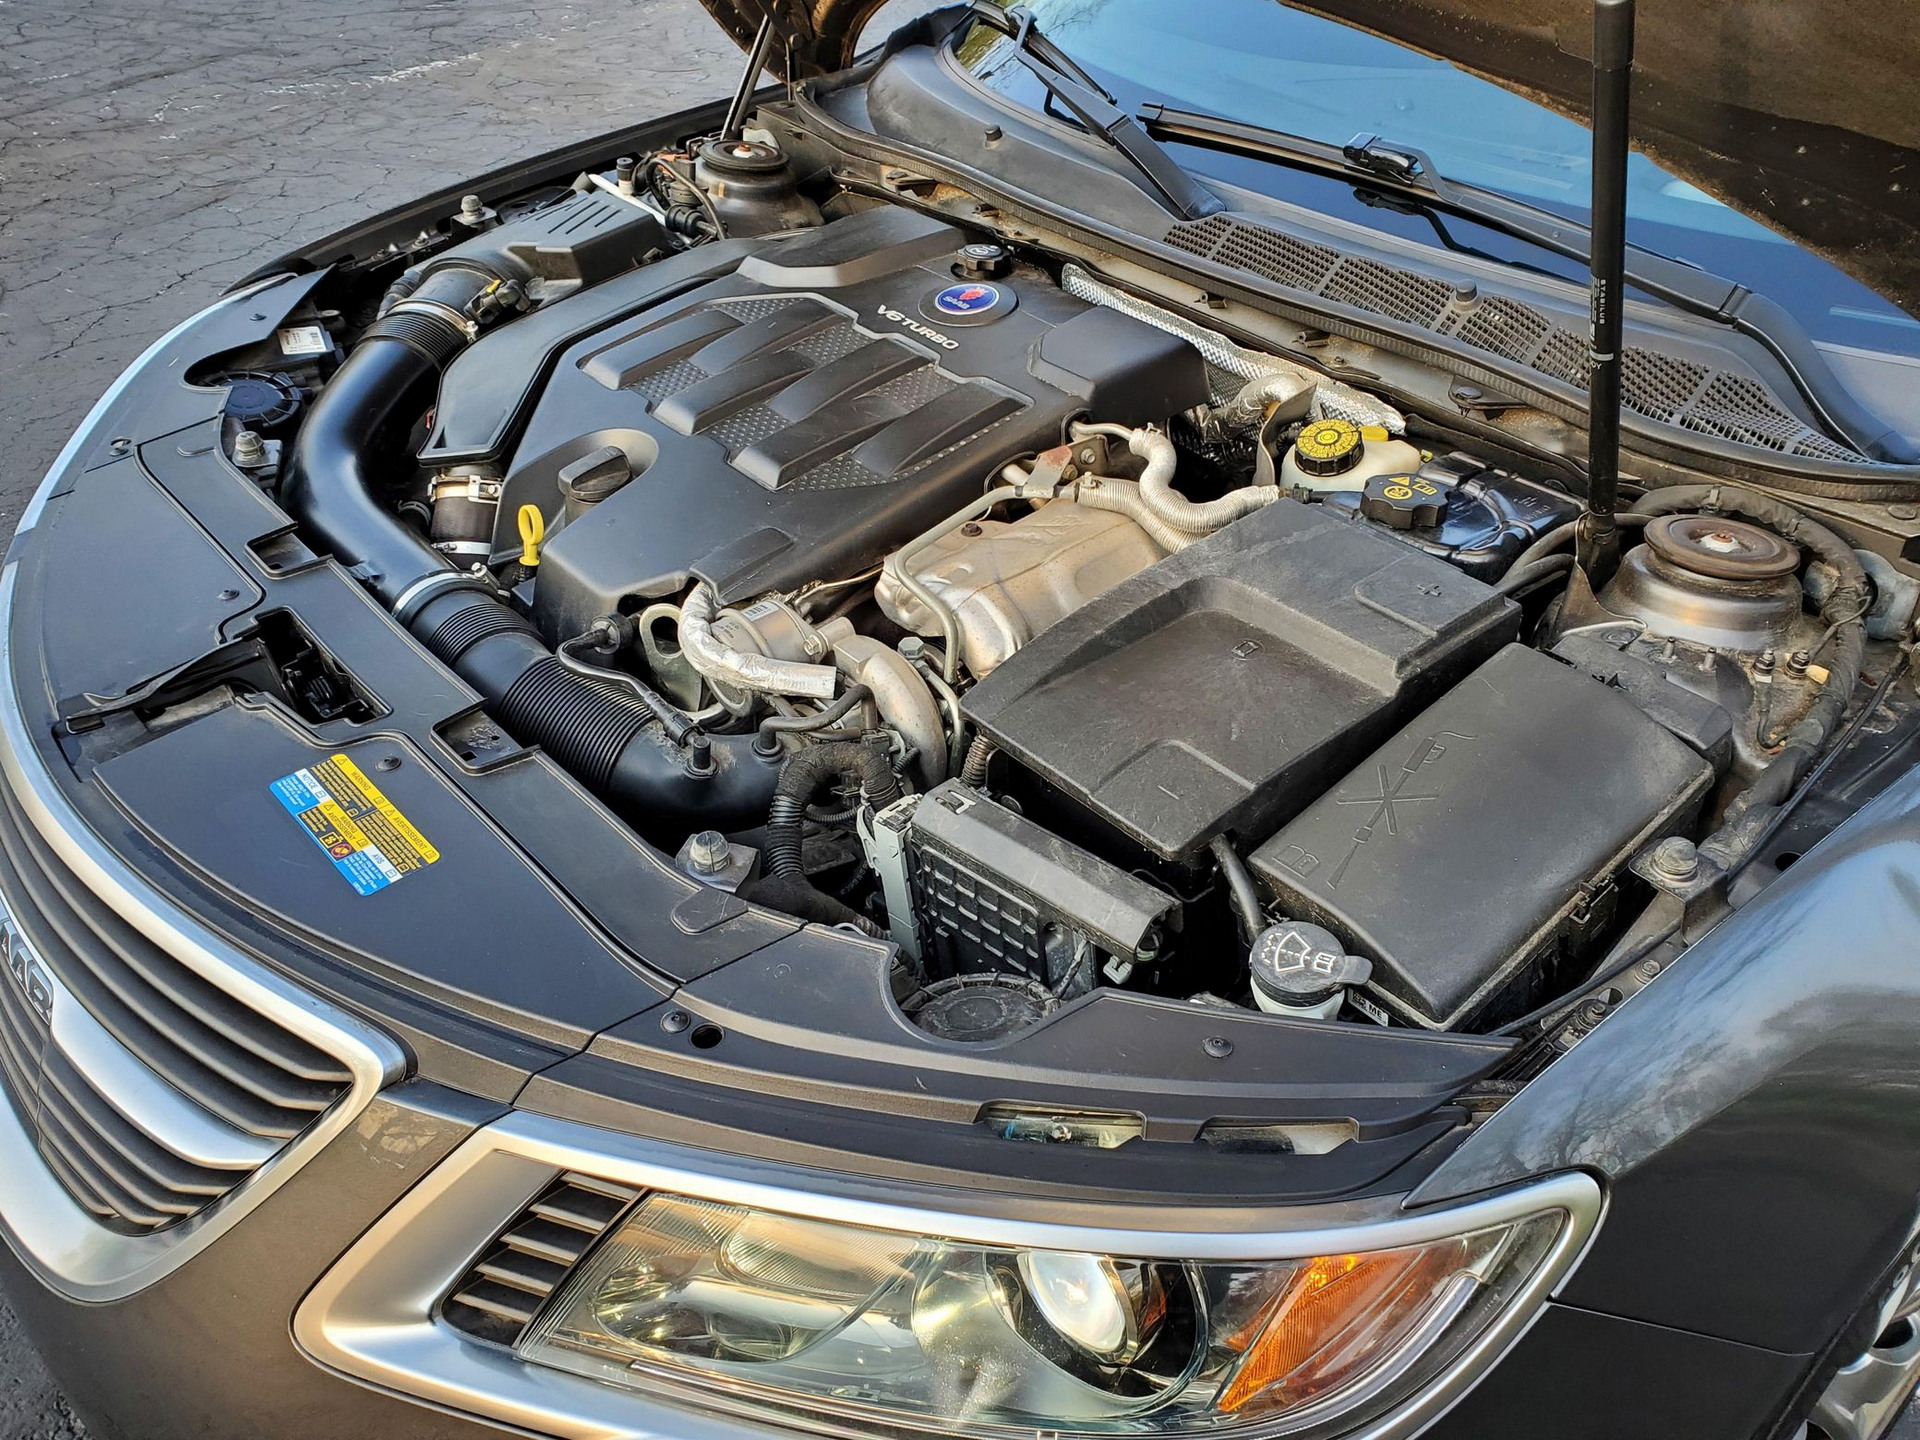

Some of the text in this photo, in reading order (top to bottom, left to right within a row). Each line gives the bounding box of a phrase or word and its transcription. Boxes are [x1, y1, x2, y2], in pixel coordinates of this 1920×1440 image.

[943, 296, 970, 309] SAAB
[301, 773, 318, 789] NOTICE
[351, 771, 371, 791] WARNING
[327, 812, 355, 841] AVERTISSEMENT
[340, 816, 358, 834] WARNING
[393, 817, 427, 850] AVERTISSEMENT
[372, 853, 385, 865] AVIS
